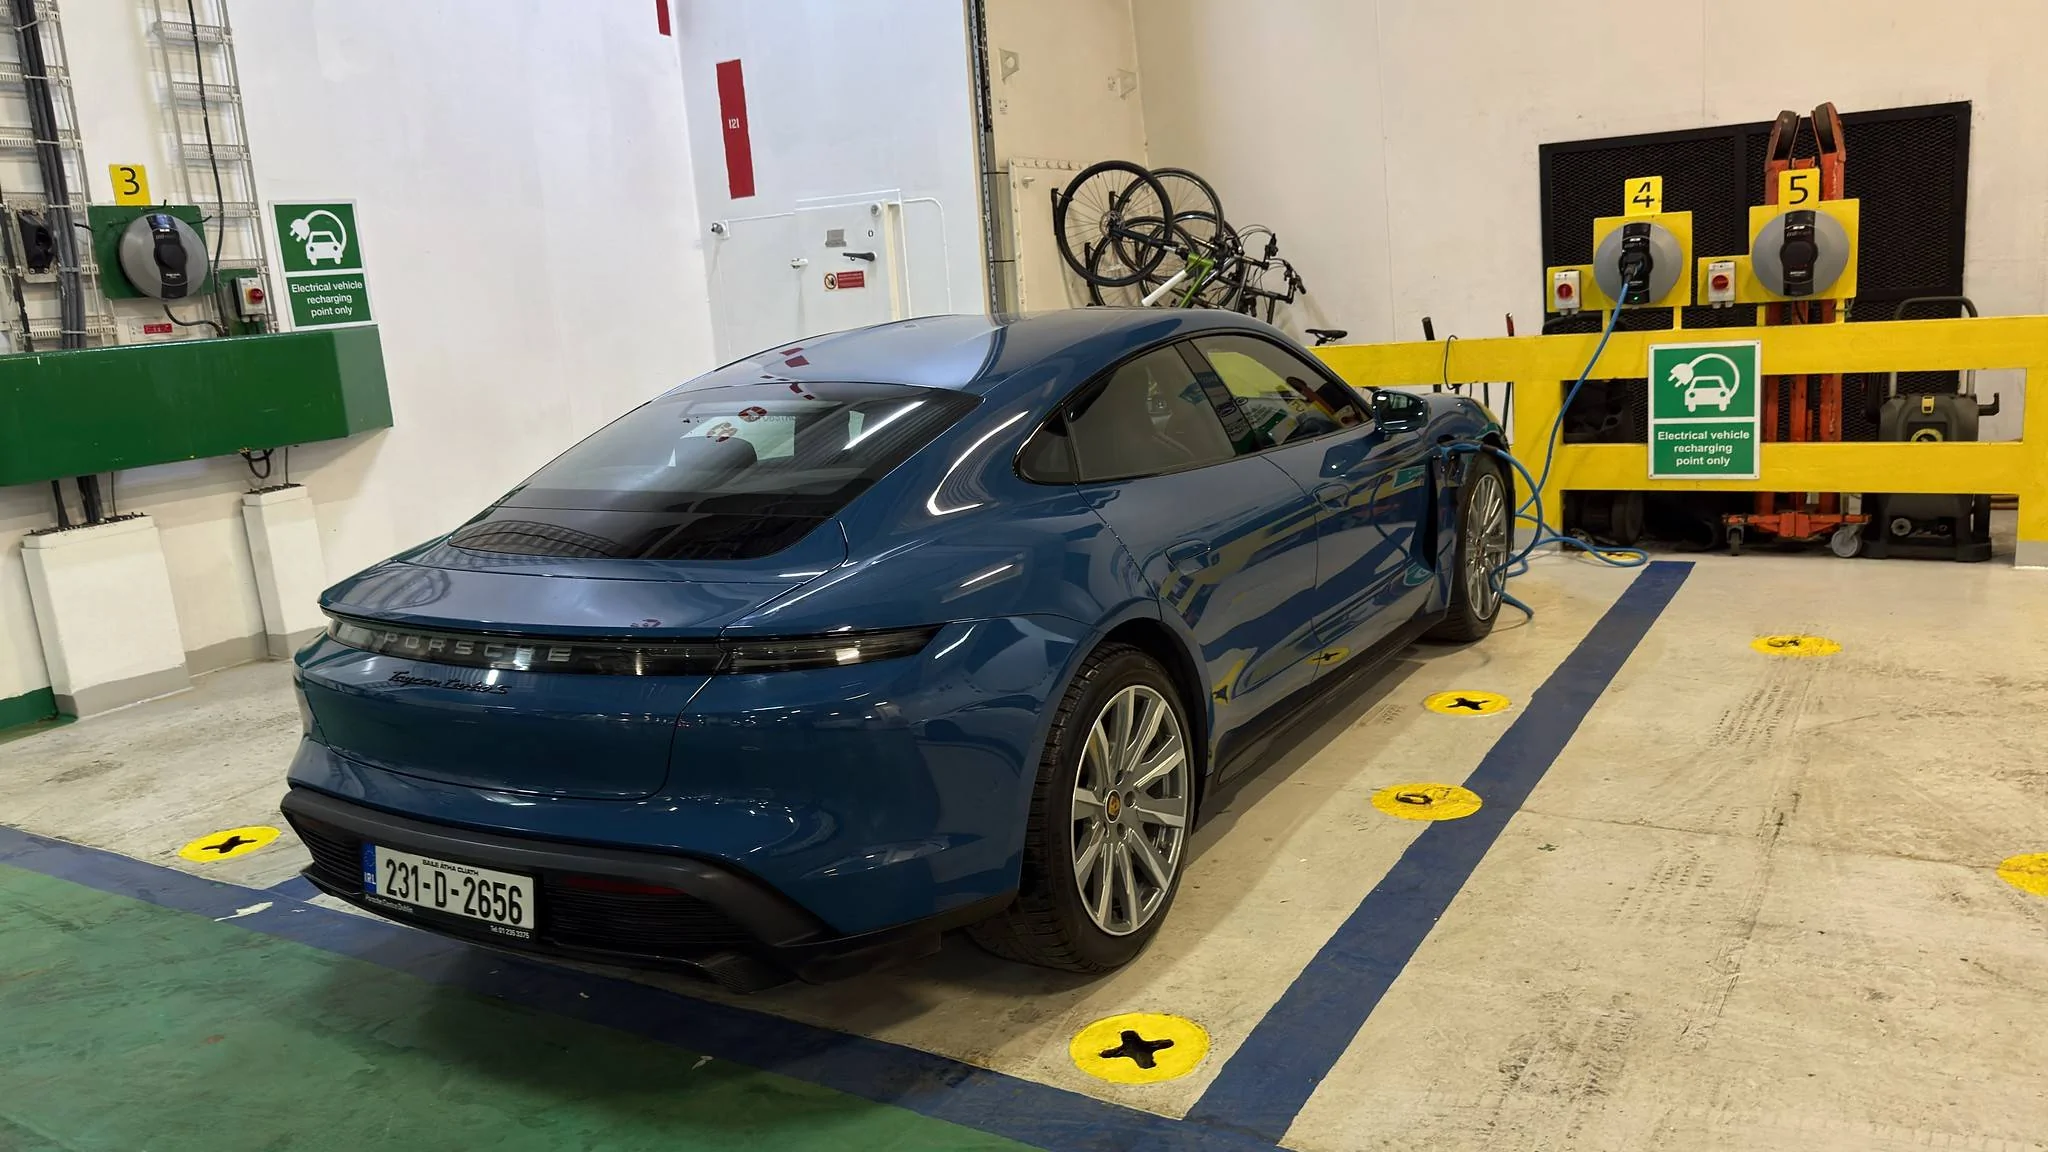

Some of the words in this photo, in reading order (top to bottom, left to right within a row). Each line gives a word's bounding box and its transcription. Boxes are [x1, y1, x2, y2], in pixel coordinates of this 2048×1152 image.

[728, 117, 740, 129] 121
[119, 167, 141, 195] 3
[1632, 181, 1655, 208] 4
[1789, 175, 1809, 205] 5
[291, 282, 332, 293] Electrical
[332, 281, 363, 291] vehicle
[307, 294, 353, 305] recharging
[311, 307, 333, 319] point
[334, 305, 353, 316] only
[1657, 430, 1708, 441] Electrical
[1710, 430, 1750, 440] vehicle
[1674, 443, 1733, 454] recharging
[1676, 455, 1704, 467] point
[1706, 455, 1731, 467] only
[384, 631, 572, 663] PORSCHE
[363, 871, 377, 885] IRL
[386, 858, 523, 925] 231-D-2656
